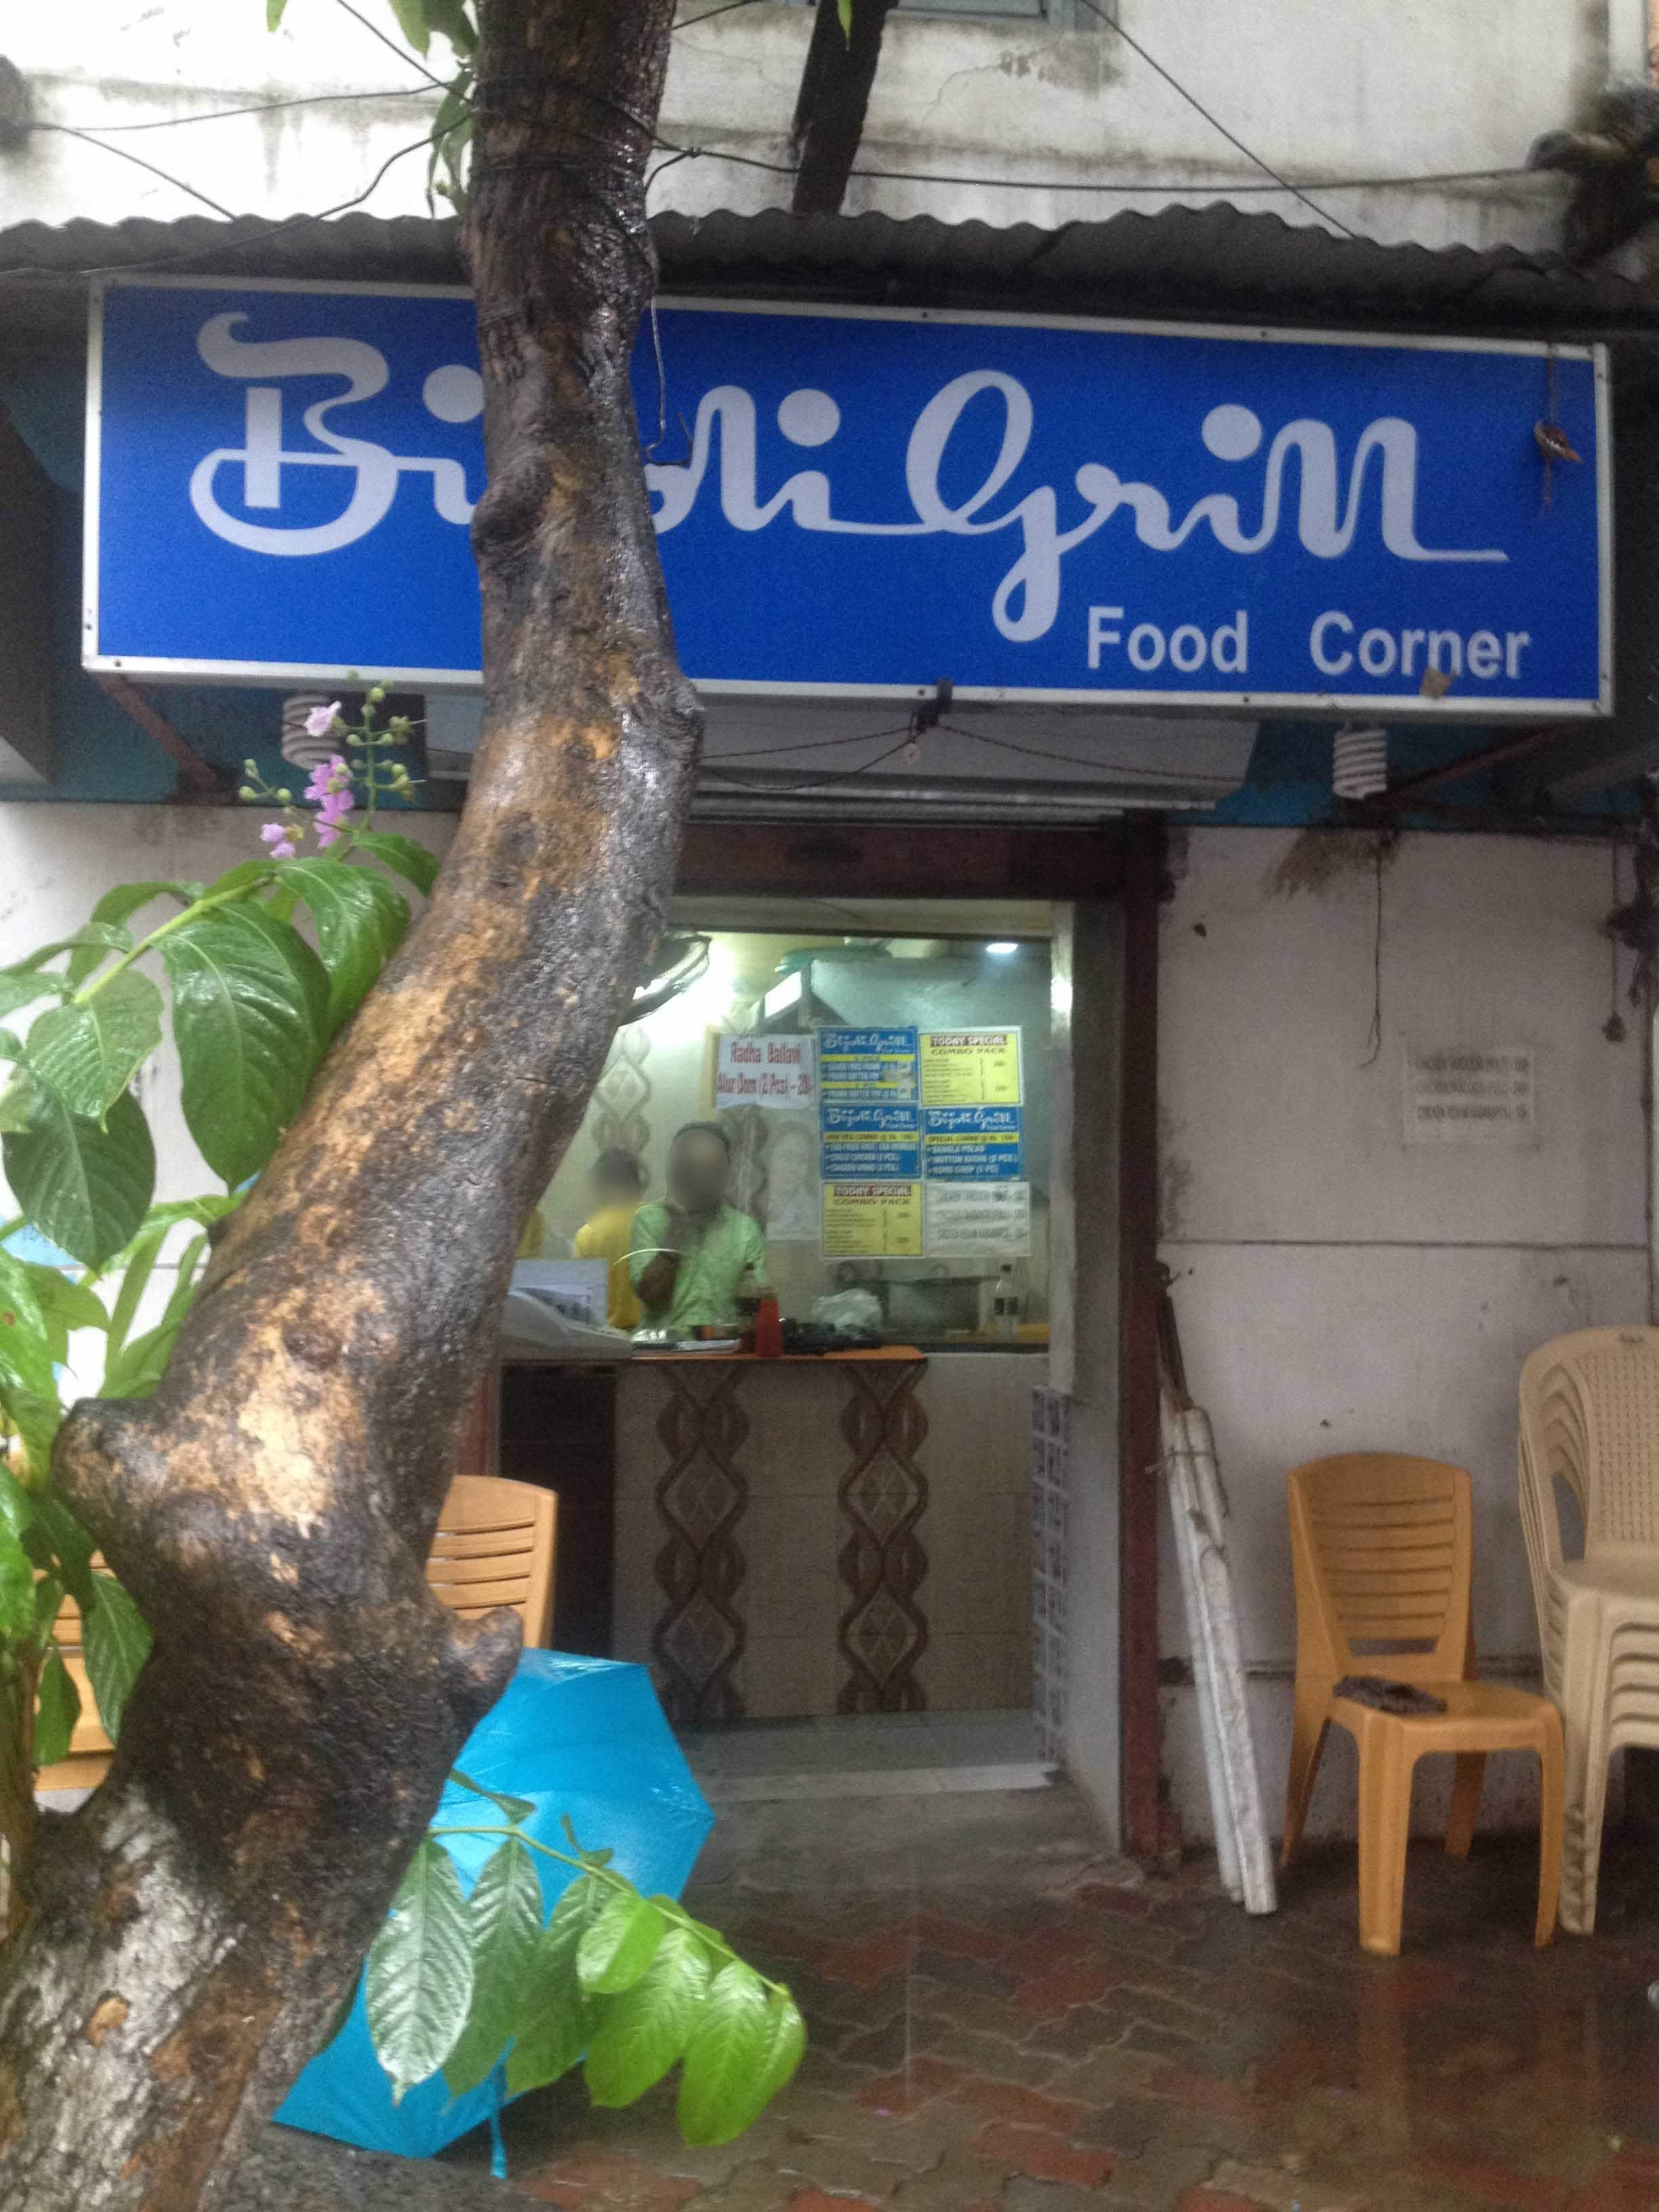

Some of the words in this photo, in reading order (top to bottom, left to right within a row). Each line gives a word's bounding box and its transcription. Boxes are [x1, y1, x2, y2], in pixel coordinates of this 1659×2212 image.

[1087, 606, 1249, 673] Food
[1309, 610, 1531, 680] Corner
[932, 1036, 966, 1046] TODAY
[968, 1035, 1004, 1045] SPECIAL
[731, 1041, 761, 1063] Radha
[835, 1186, 868, 1197] TODAY
[872, 1186, 911, 1196] SPECIAL
